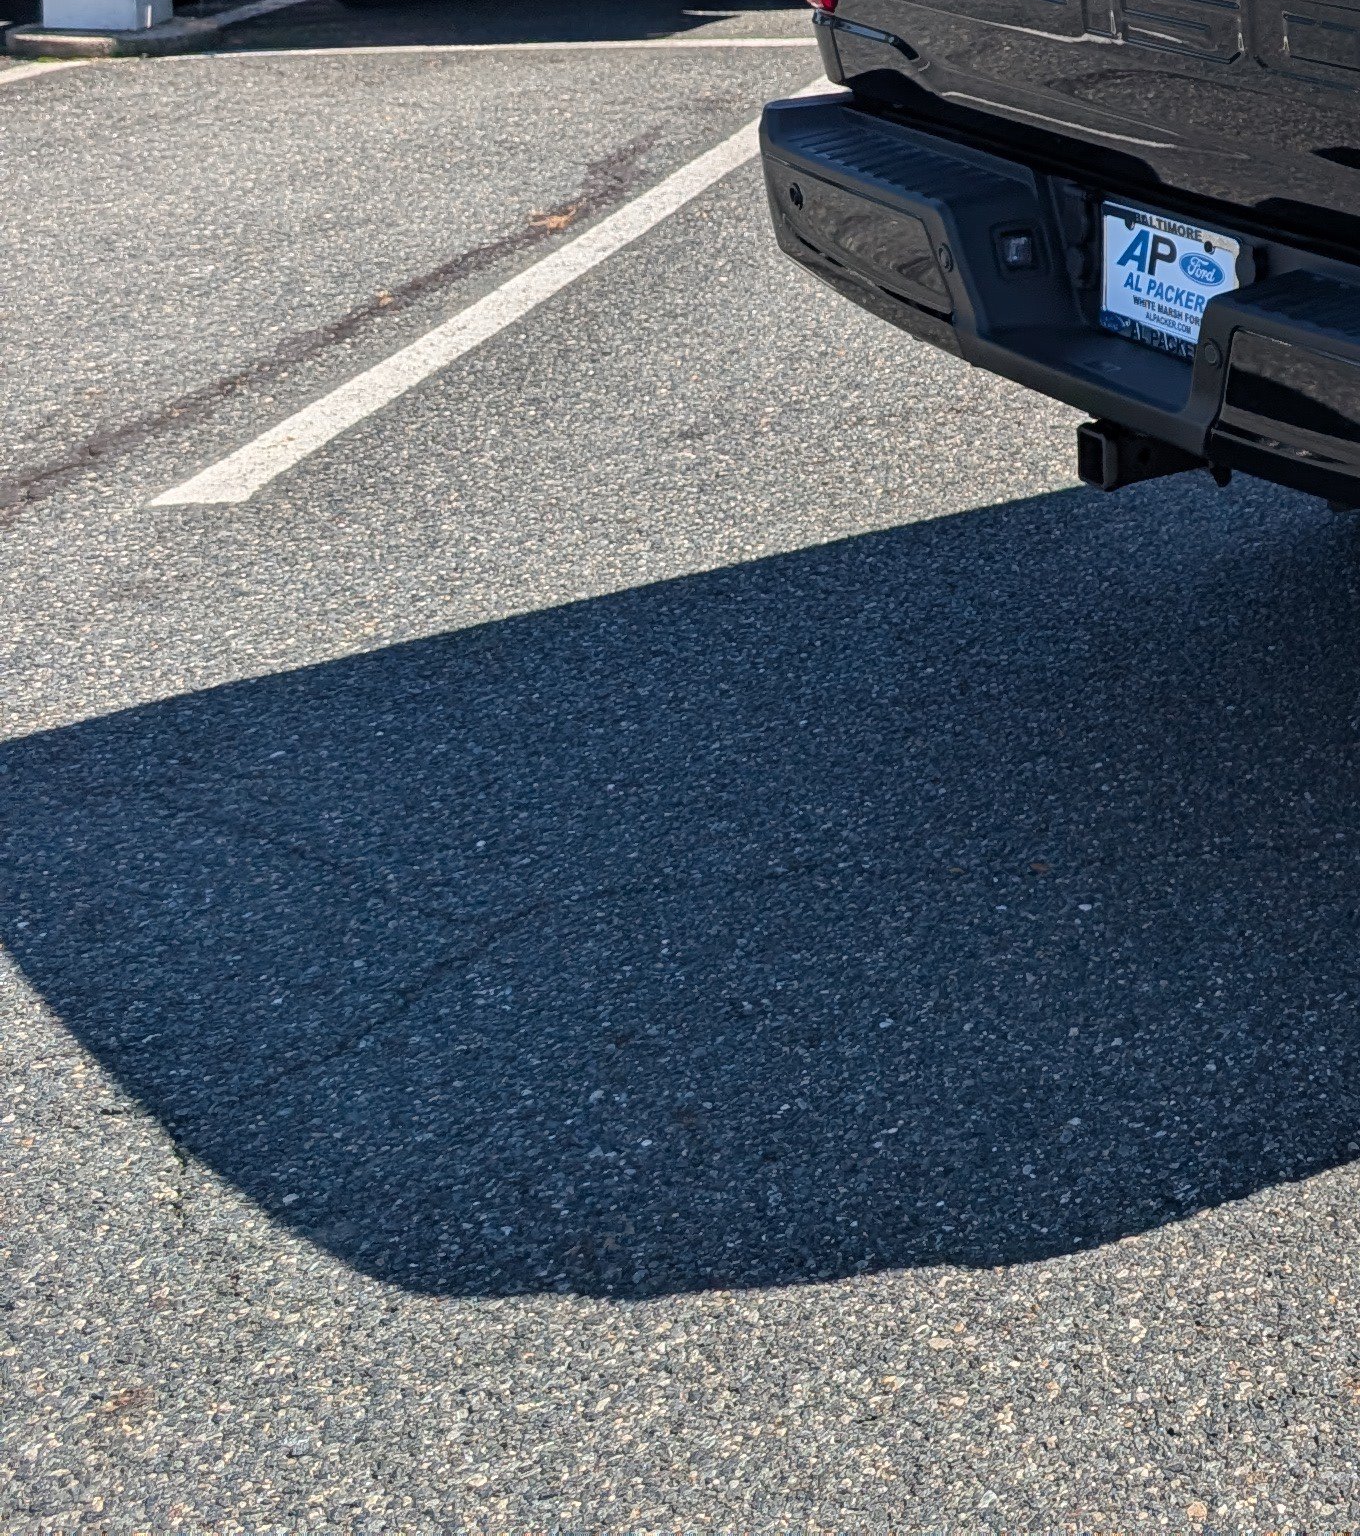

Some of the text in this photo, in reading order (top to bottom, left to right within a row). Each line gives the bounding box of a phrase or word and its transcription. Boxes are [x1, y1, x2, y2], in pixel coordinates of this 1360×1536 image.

[1135, 213, 1203, 243] BALTIMORE
[1116, 228, 1177, 276] AP
[1187, 256, 1216, 283] Ford
[1123, 271, 1206, 314] AL PACKER
[1133, 294, 1200, 327] WHITE MARSH FOR
[1150, 327, 1195, 359] PACKE
